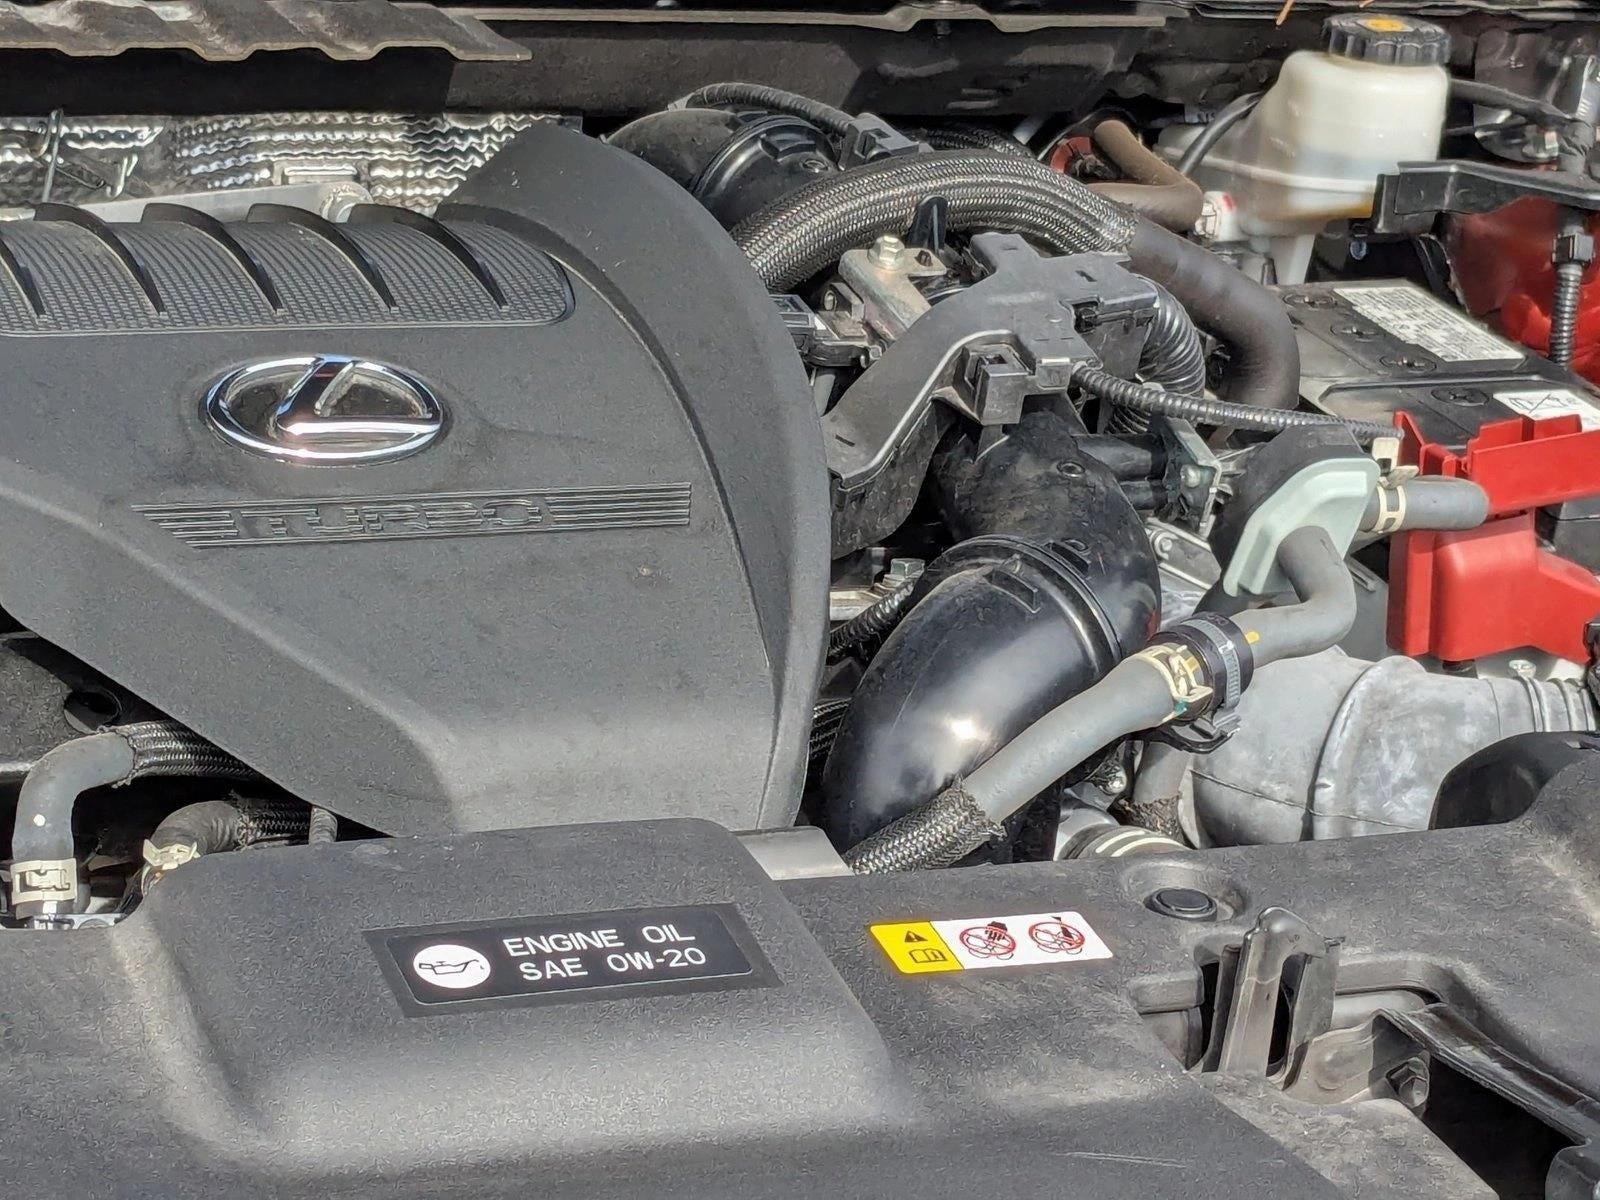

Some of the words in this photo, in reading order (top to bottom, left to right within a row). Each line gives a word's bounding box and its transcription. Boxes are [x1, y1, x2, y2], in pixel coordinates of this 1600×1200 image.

[503, 929, 624, 956] ENGINE
[642, 924, 695, 943] OIL
[519, 957, 588, 981] SAE
[607, 947, 706, 973] 0W-20
